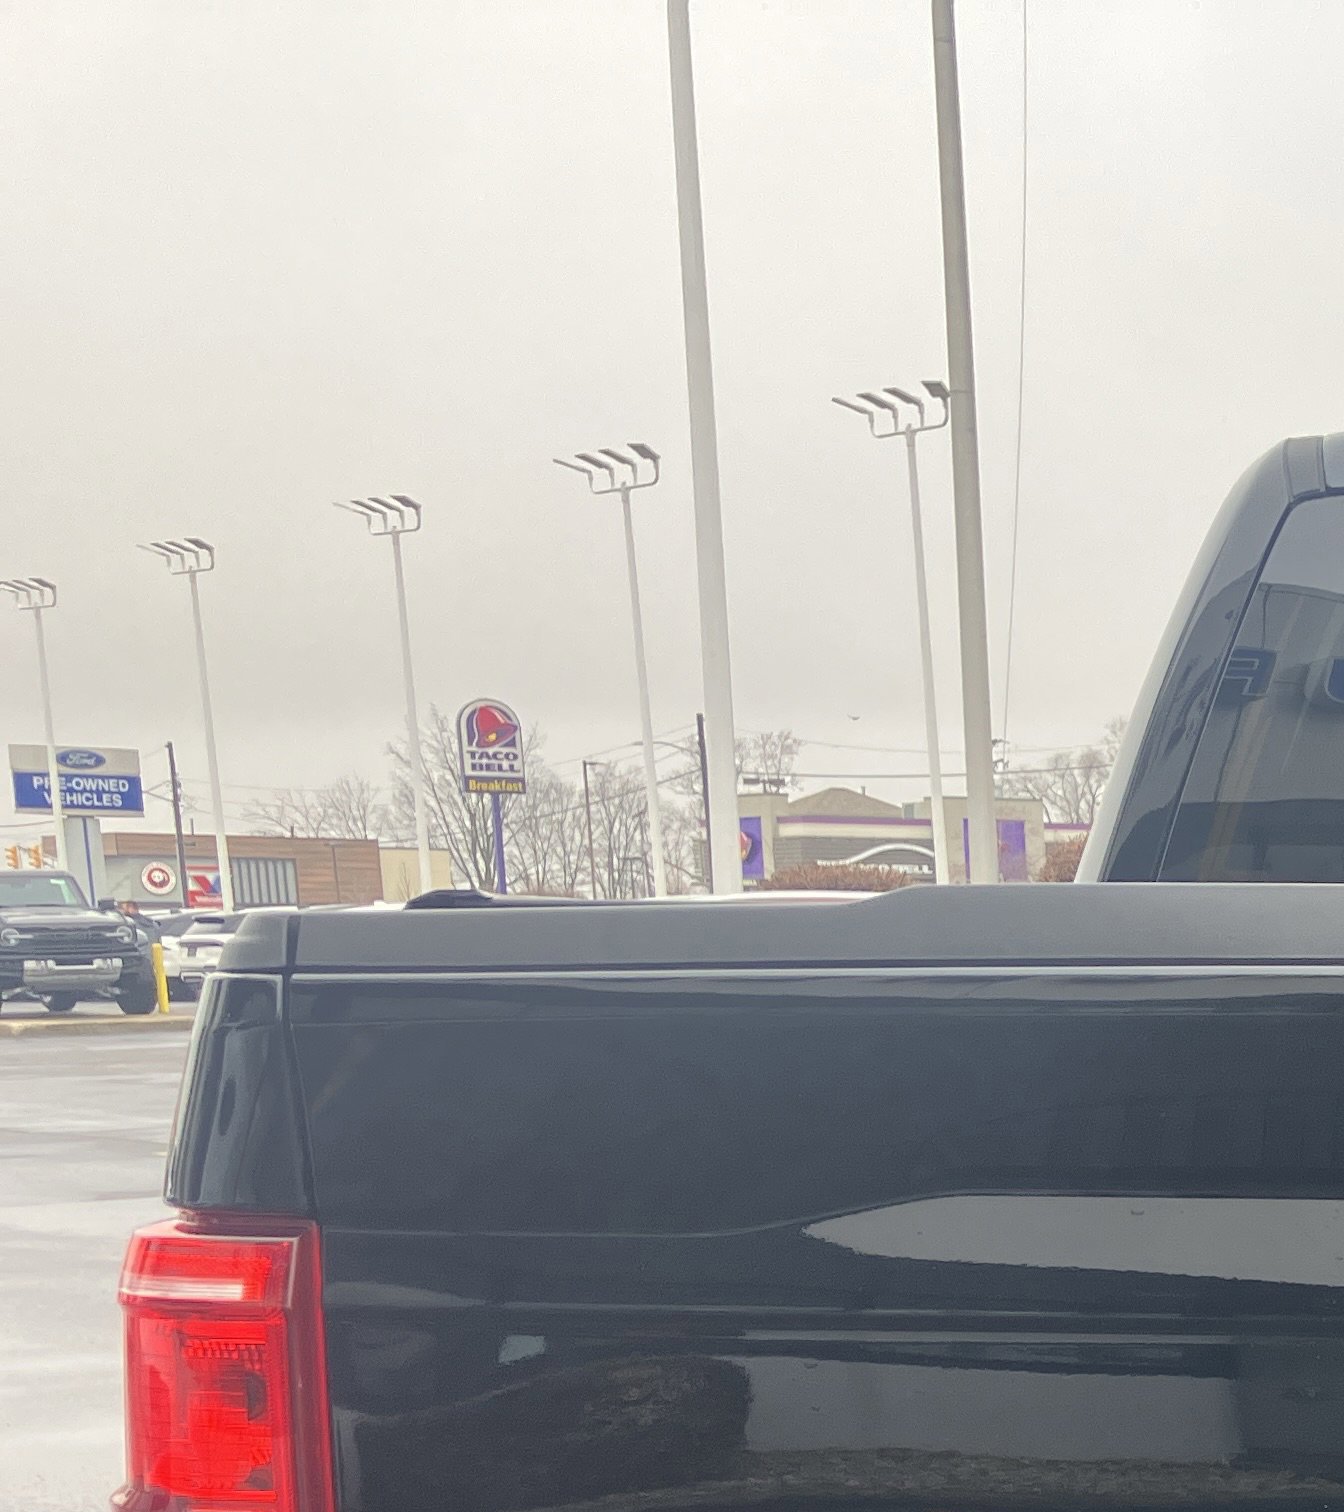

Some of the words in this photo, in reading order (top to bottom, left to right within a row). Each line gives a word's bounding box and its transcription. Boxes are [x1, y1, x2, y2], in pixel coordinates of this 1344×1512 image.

[466, 750, 520, 761] TACO
[470, 762, 521, 773] BELL
[468, 779, 523, 791] Breakfast
